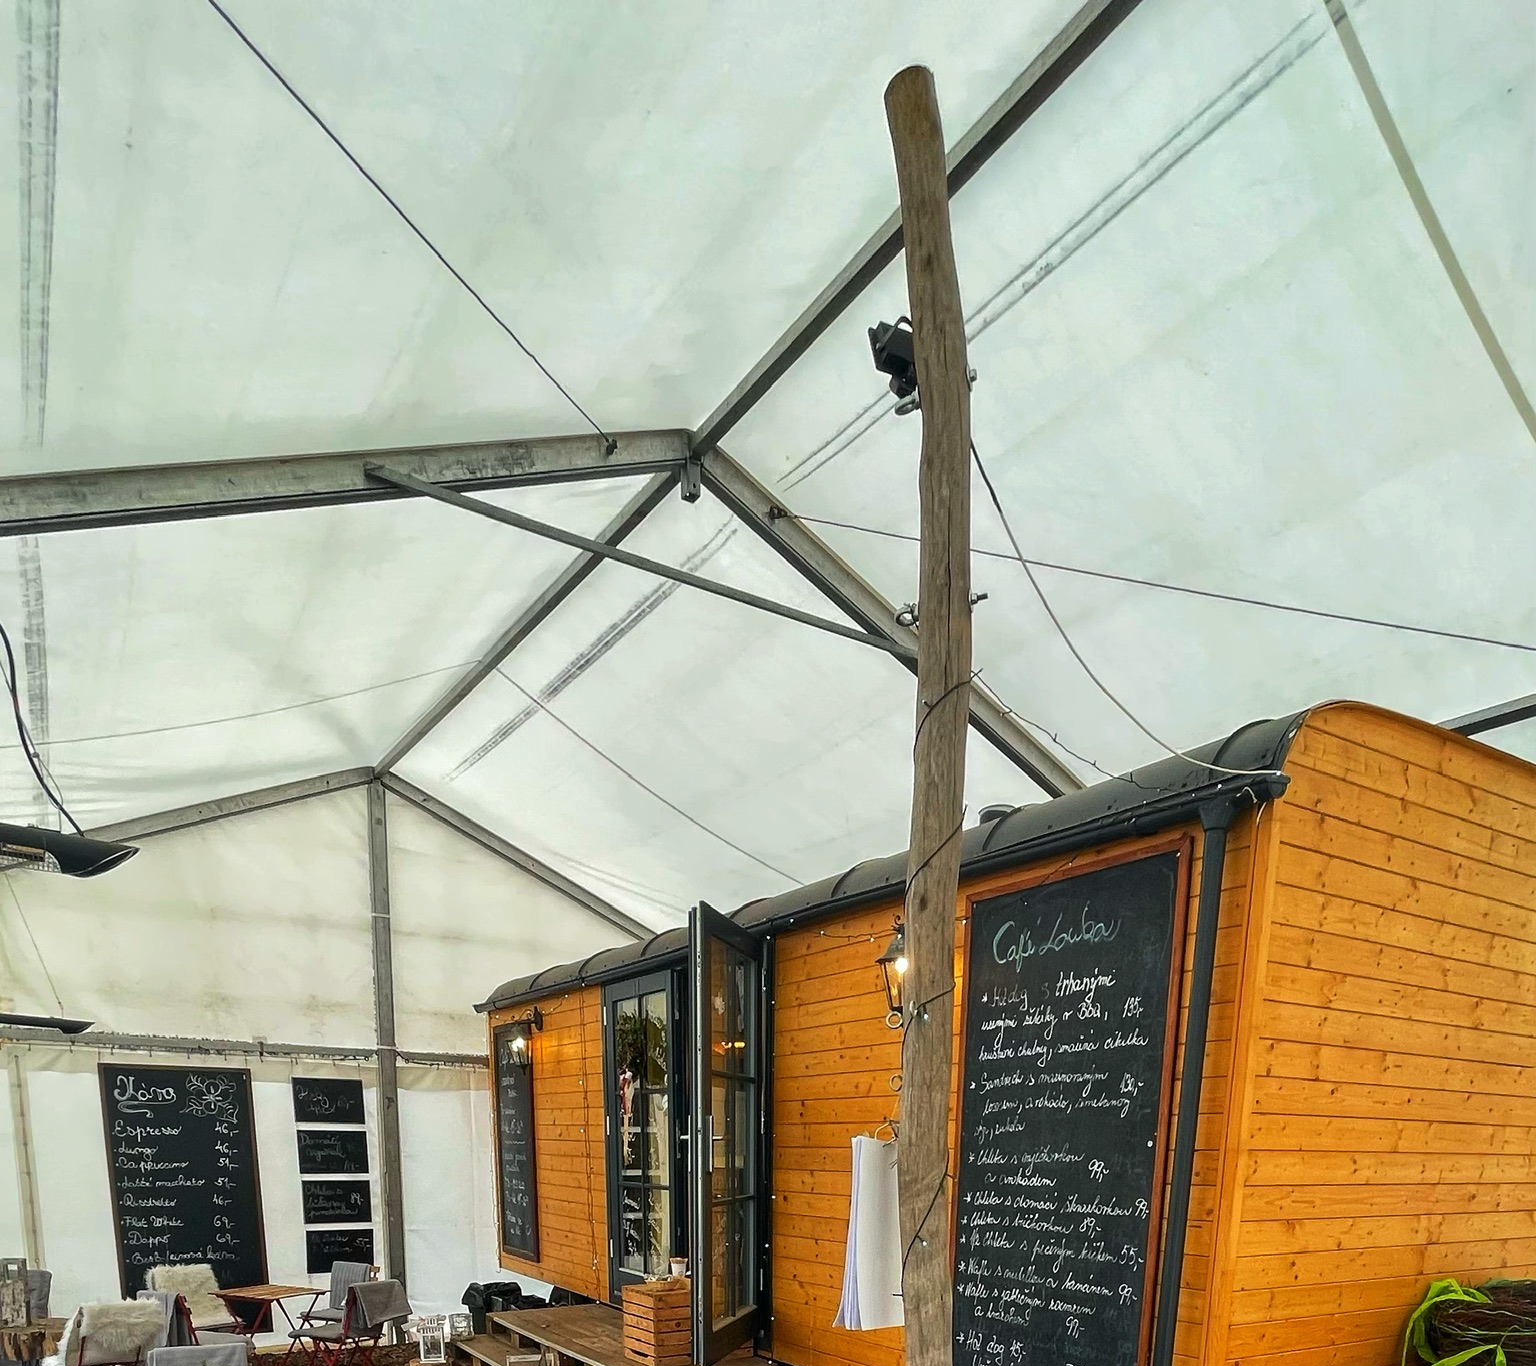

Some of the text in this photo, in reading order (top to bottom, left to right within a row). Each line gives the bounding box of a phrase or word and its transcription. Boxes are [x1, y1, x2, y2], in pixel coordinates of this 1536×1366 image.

[991, 920, 1036, 973] Café
[115, 1119, 183, 1143] Espresso
[117, 1141, 159, 1162] Lungo
[122, 1215, 149, 1228] Flat
[973, 1304, 986, 1318] a
[985, 1335, 1006, 1366] dog
